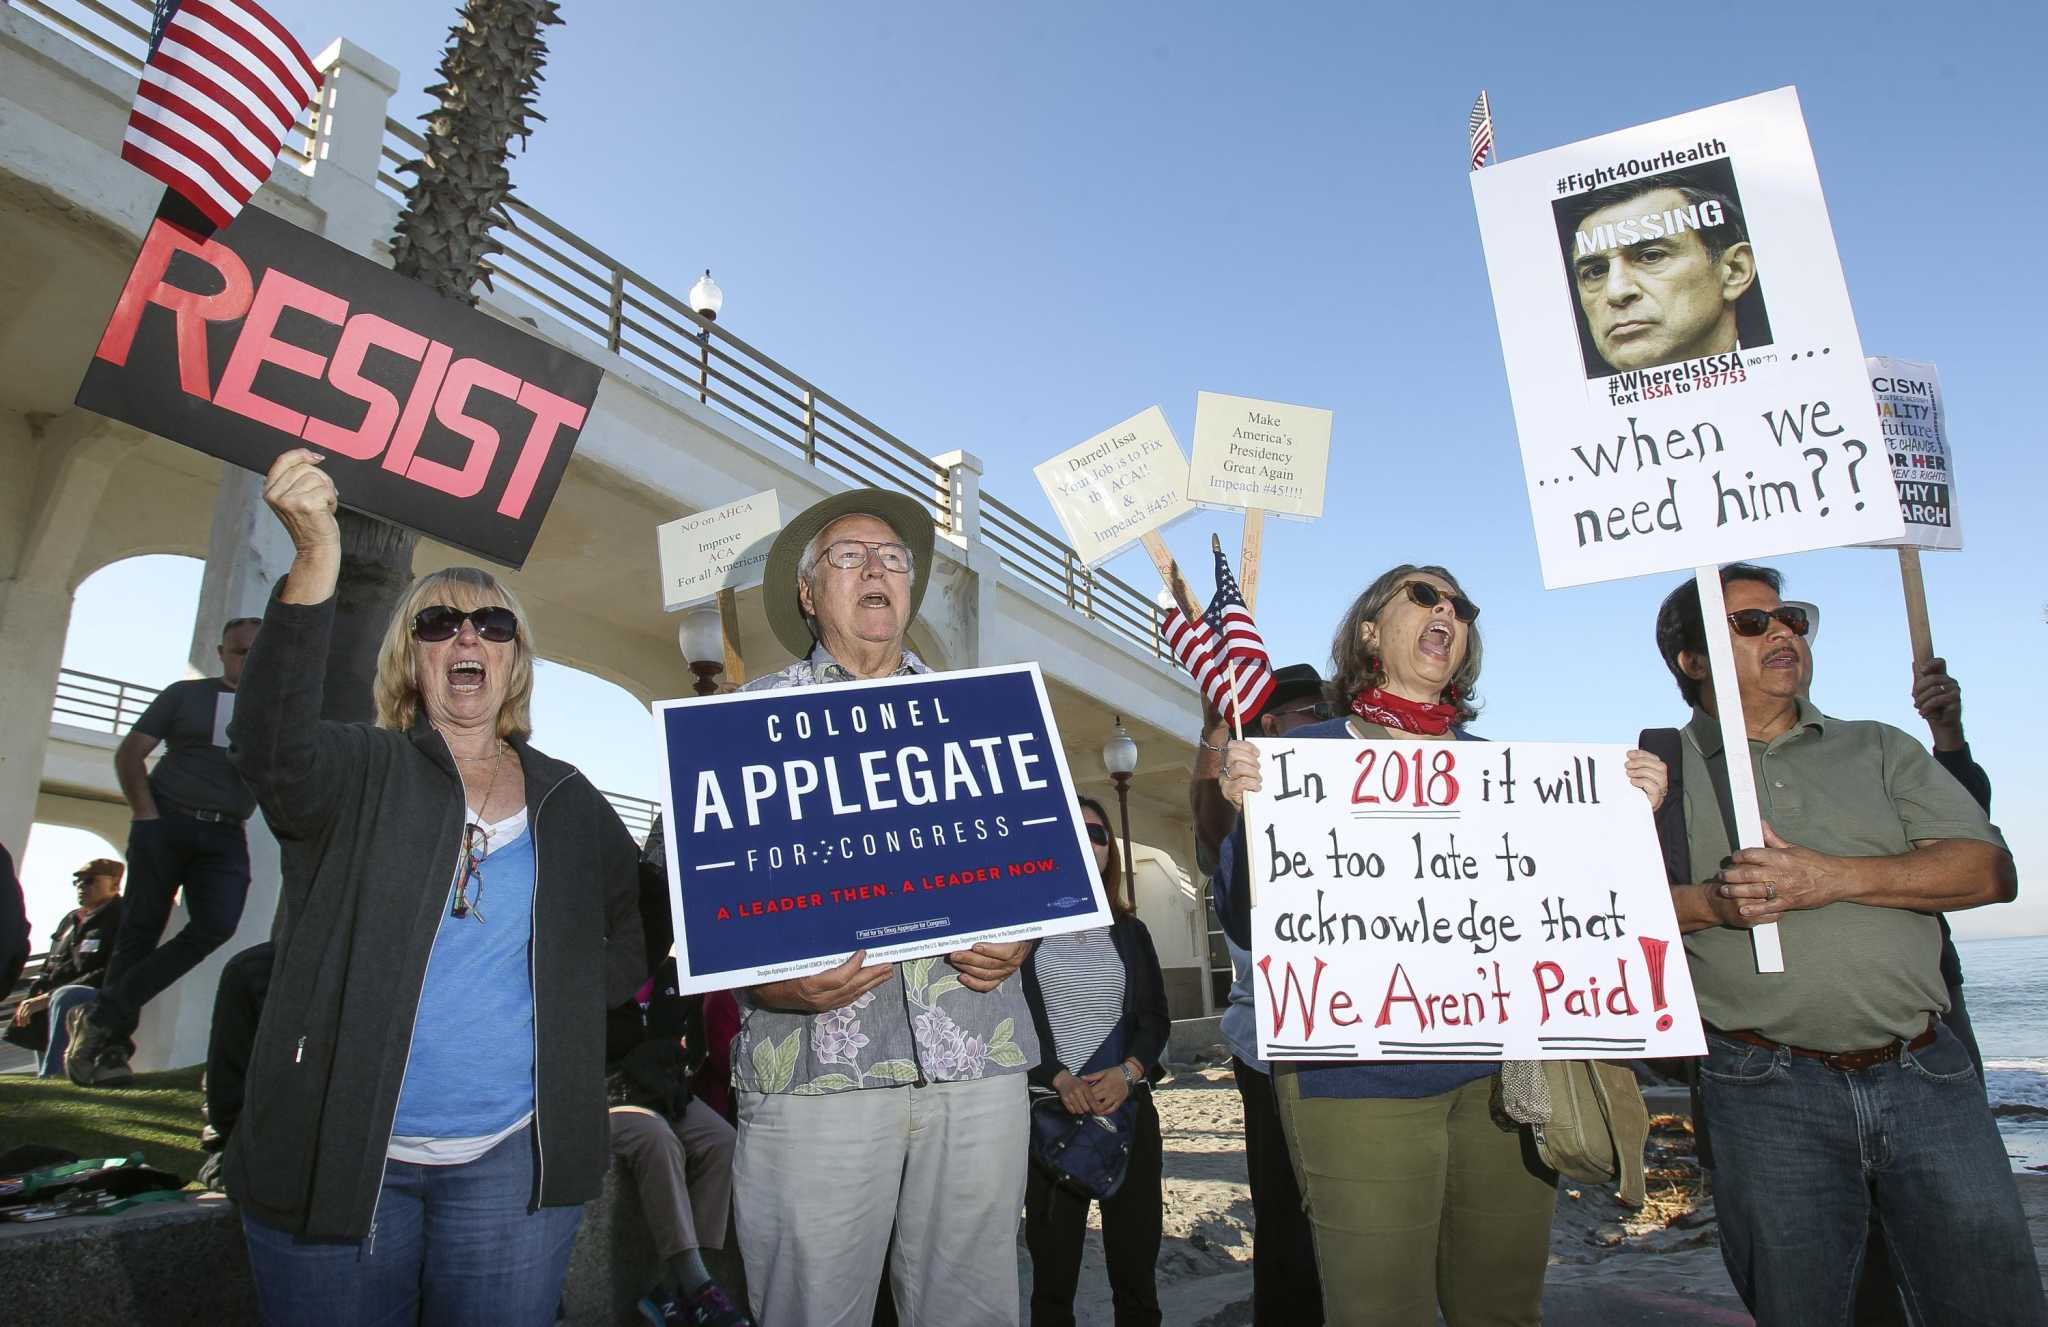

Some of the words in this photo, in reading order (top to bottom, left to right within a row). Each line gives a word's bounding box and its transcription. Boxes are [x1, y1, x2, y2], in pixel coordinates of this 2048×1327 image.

[1575, 199, 1725, 257] MISSING
[96, 216, 587, 519] RESIST
[1608, 353, 1744, 393] #WhereIsISSA
[1872, 377, 1927, 396] CISM
[1609, 391, 1640, 407] Text
[1642, 384, 1673, 400] ISSA
[1675, 382, 1691, 394] to
[1694, 369, 1747, 390] 787753
[1232, 427, 1292, 446] America's
[1248, 411, 1281, 427] Make
[1762, 400, 1845, 447] we
[1880, 418, 1934, 439] future
[1067, 442, 1111, 472] Darrell
[1112, 432, 1137, 449] Issa
[1230, 443, 1293, 465] Presidency
[1884, 437, 1897, 450] TE
[1899, 437, 1937, 453] CHANGE
[1911, 453, 1946, 471] HER
[1058, 477, 1089, 497] Your
[1093, 464, 1114, 480] Job
[1116, 458, 1127, 471] is
[1127, 450, 1140, 463] to
[1141, 439, 1163, 455] Fix
[1088, 487, 1105, 503] th
[1111, 464, 1151, 493] ACA!!
[1223, 460, 1256, 475] Great
[1260, 465, 1294, 481] Again
[1919, 470, 1946, 482] RIGHTS
[1123, 494, 1135, 507] &
[1209, 475, 1259, 493] Impeach
[1263, 482, 1303, 500] #45!!!!
[1573, 477, 1683, 547] need
[1713, 439, 1868, 528] him??
[1934, 486, 1939, 503] I
[681, 521, 699, 533] NO
[702, 517, 714, 526] on
[718, 504, 752, 520] AHCA
[1094, 510, 1146, 542] Impeach
[1146, 491, 1178, 513] #45!!
[1900, 504, 1947, 525] ARCH
[699, 532, 741, 552] Improve
[709, 548, 735, 563] ACA
[678, 576, 698, 587] For
[699, 569, 711, 581] all
[714, 553, 769, 576] Americans
[768, 698, 950, 742] COLONEL
[693, 732, 1048, 833] APPLEGATE
[1272, 748, 1327, 804] In
[1351, 748, 1459, 807] 2018
[1482, 748, 1516, 804] it
[1533, 756, 1600, 804] will
[747, 841, 806, 872] FOR
[841, 816, 1010, 860] CONGRESS
[1265, 824, 1314, 883] be
[1326, 827, 1385, 879] too
[1411, 832, 1479, 880] late
[1495, 832, 1537, 882] to
[717, 906, 731, 921] A
[739, 892, 823, 918] LEADER
[831, 884, 894, 903] THEN.
[903, 879, 914, 893] A
[922, 868, 1000, 891] LEADER
[1008, 859, 1060, 878] NOW.
[1274, 890, 1522, 954] acknowledge
[1541, 891, 1626, 943] that
[1257, 956, 1363, 1041] We
[1375, 961, 1511, 1032] Aren't
[1533, 936, 1673, 1033] Paid!
